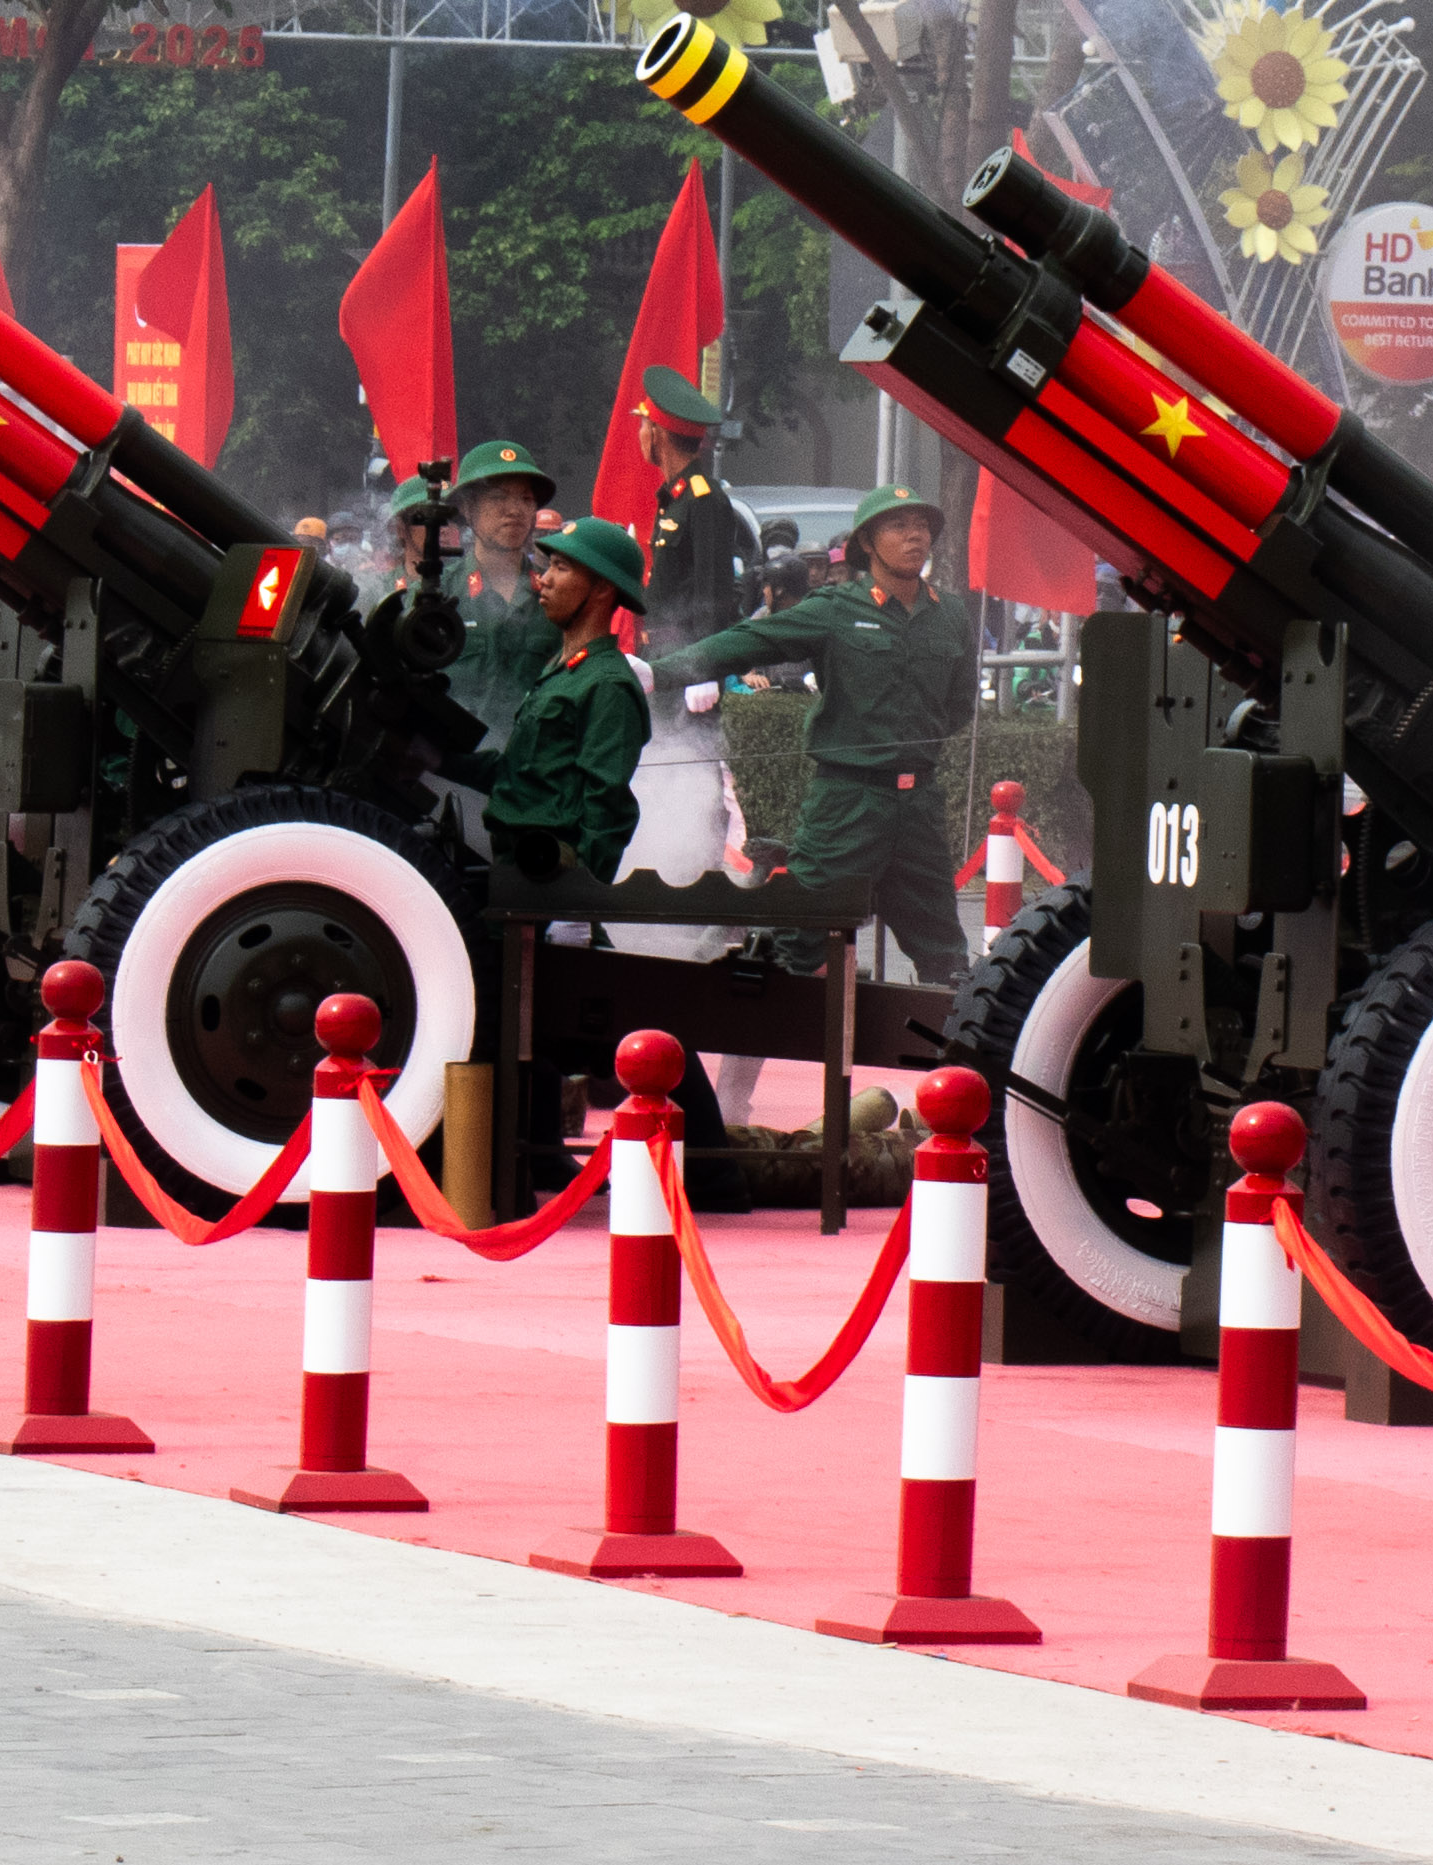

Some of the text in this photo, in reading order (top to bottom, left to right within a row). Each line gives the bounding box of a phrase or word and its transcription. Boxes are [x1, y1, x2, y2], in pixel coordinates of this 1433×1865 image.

[1364, 231, 1414, 263] HD
[1341, 313, 1416, 330] COMMITTED
[1363, 332, 1392, 347] BEST
[1147, 801, 1199, 888] 013
